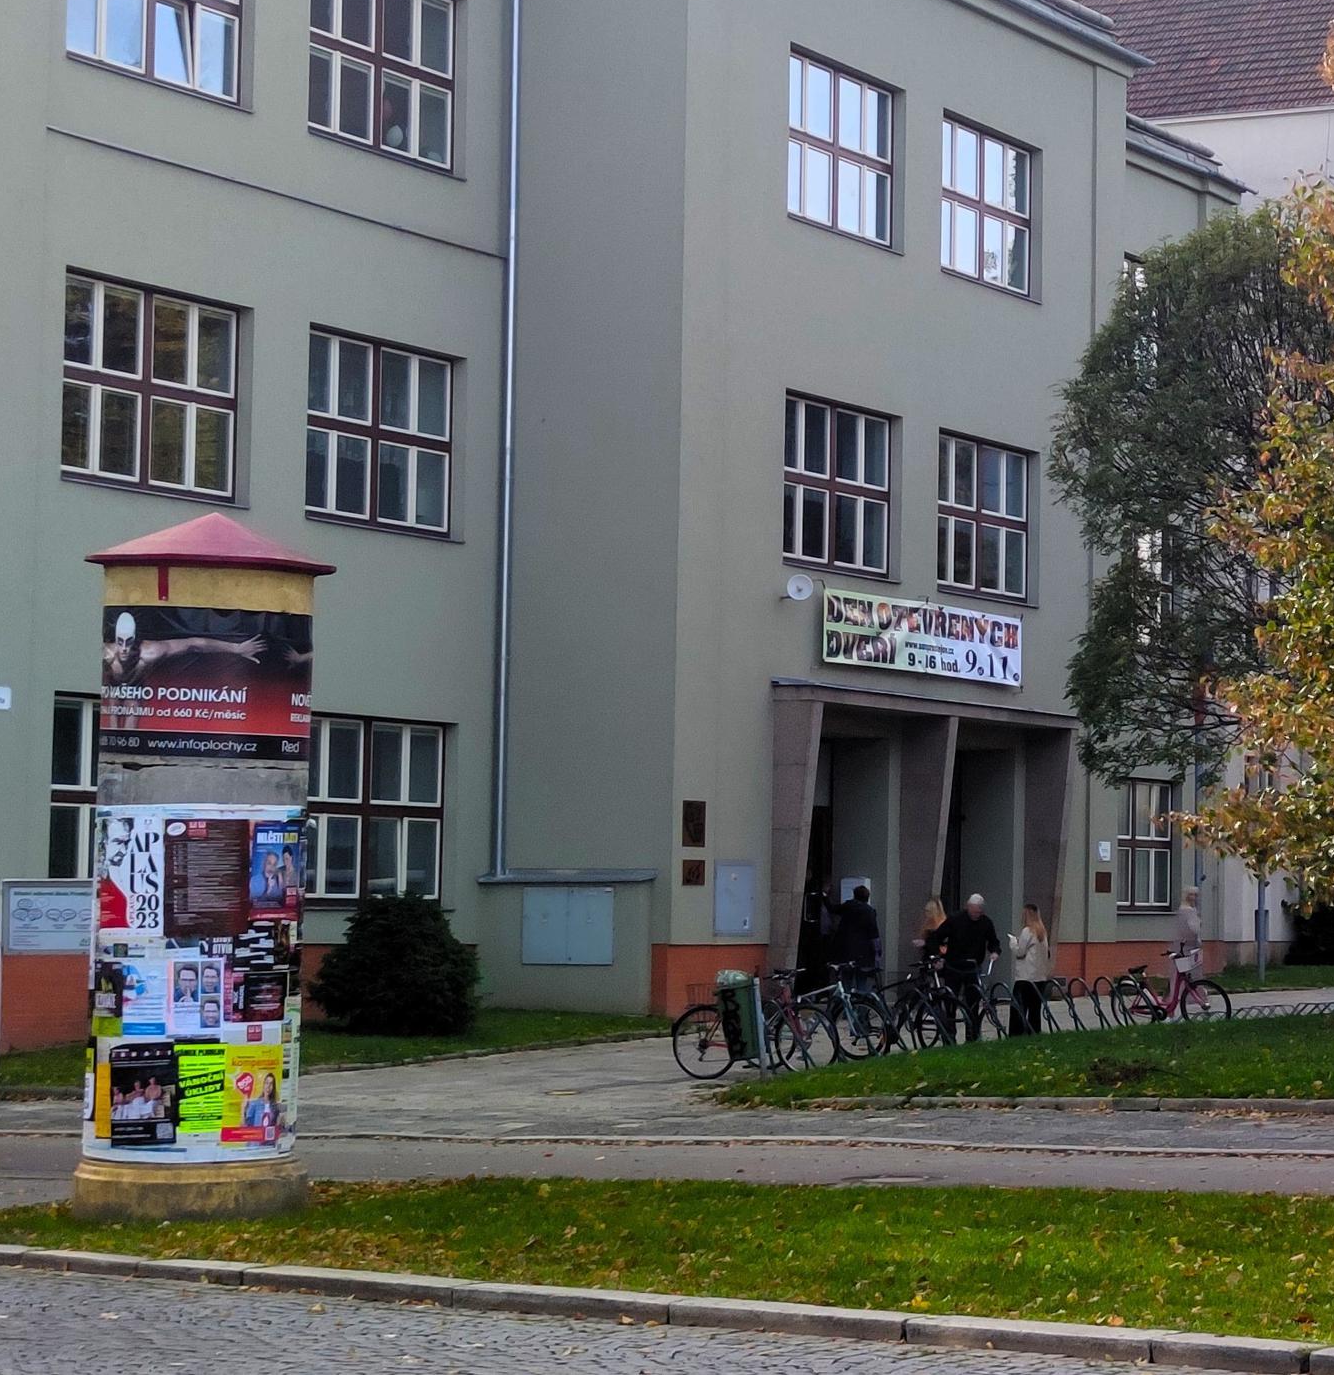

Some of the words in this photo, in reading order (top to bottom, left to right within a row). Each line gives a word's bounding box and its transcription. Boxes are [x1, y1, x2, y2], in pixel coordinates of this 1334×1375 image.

[827, 595, 874, 629] DEN
[877, 602, 1020, 650] OTEVŘENÝCH
[908, 652, 916, 667] 9
[925, 654, 936, 669] 16
[110, 683, 154, 700] VAŠEHO
[157, 686, 248, 703] PODNIKÁNÍ
[156, 708, 171, 717] od
[173, 708, 193, 718] 660
[128, 736, 140, 747] 80
[148, 738, 257, 753] www.infoplochy.cz
[136, 894, 160, 911] 20
[136, 911, 160, 929] 23
